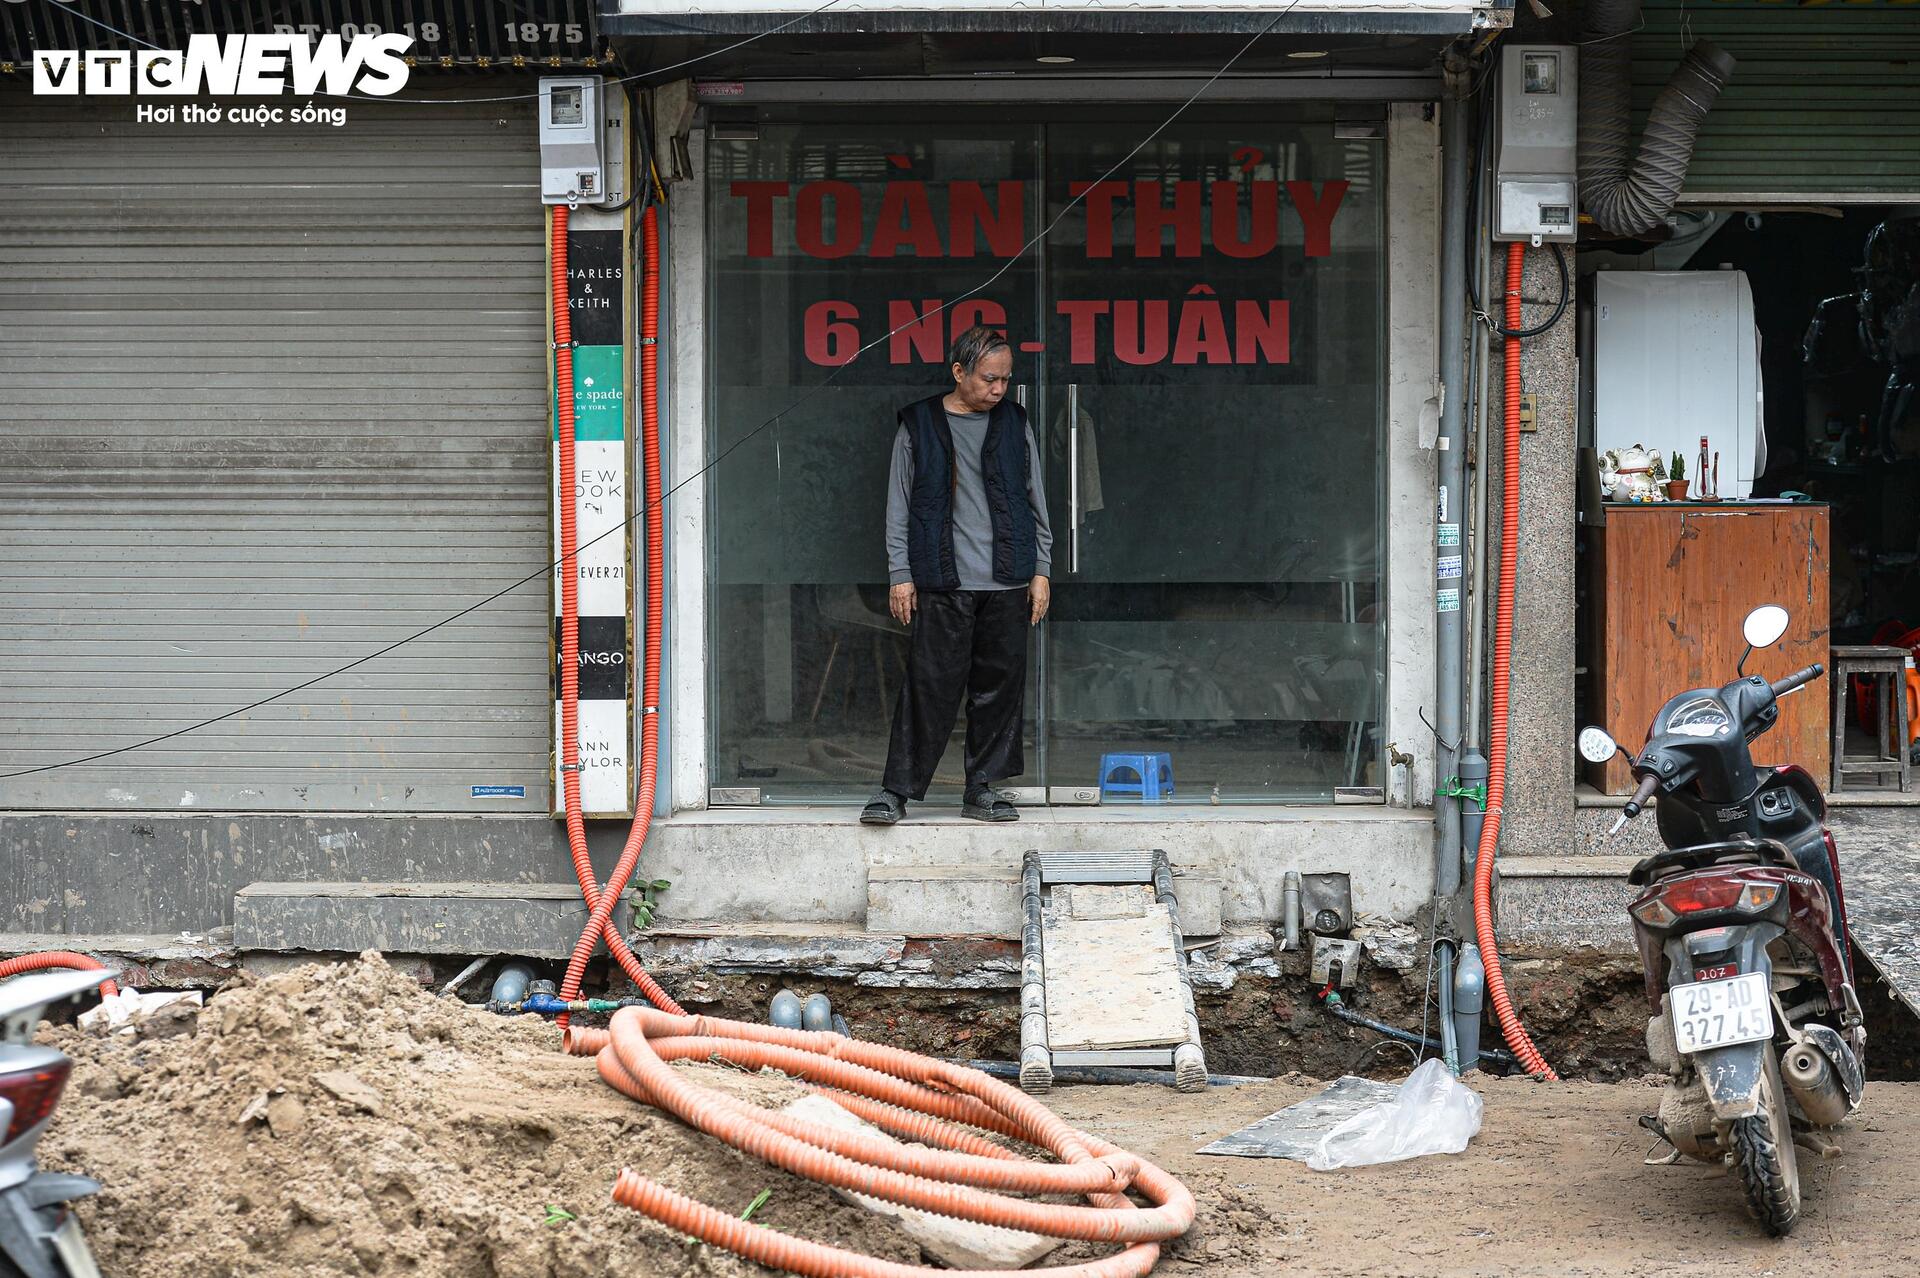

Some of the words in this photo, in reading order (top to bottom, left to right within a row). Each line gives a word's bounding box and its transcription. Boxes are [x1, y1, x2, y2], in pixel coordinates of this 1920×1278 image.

[504, 22, 583, 43] 1875
[730, 154, 1024, 259] TOÀN
[1069, 146, 1350, 258] THỦY
[567, 268, 622, 279] HARLES
[584, 283, 593, 294] &
[568, 297, 610, 309] KEITH
[804, 299, 861, 366] 6
[586, 388, 623, 402] spade
[581, 470, 617, 482] EW
[1700, 967, 1726, 980] 207
